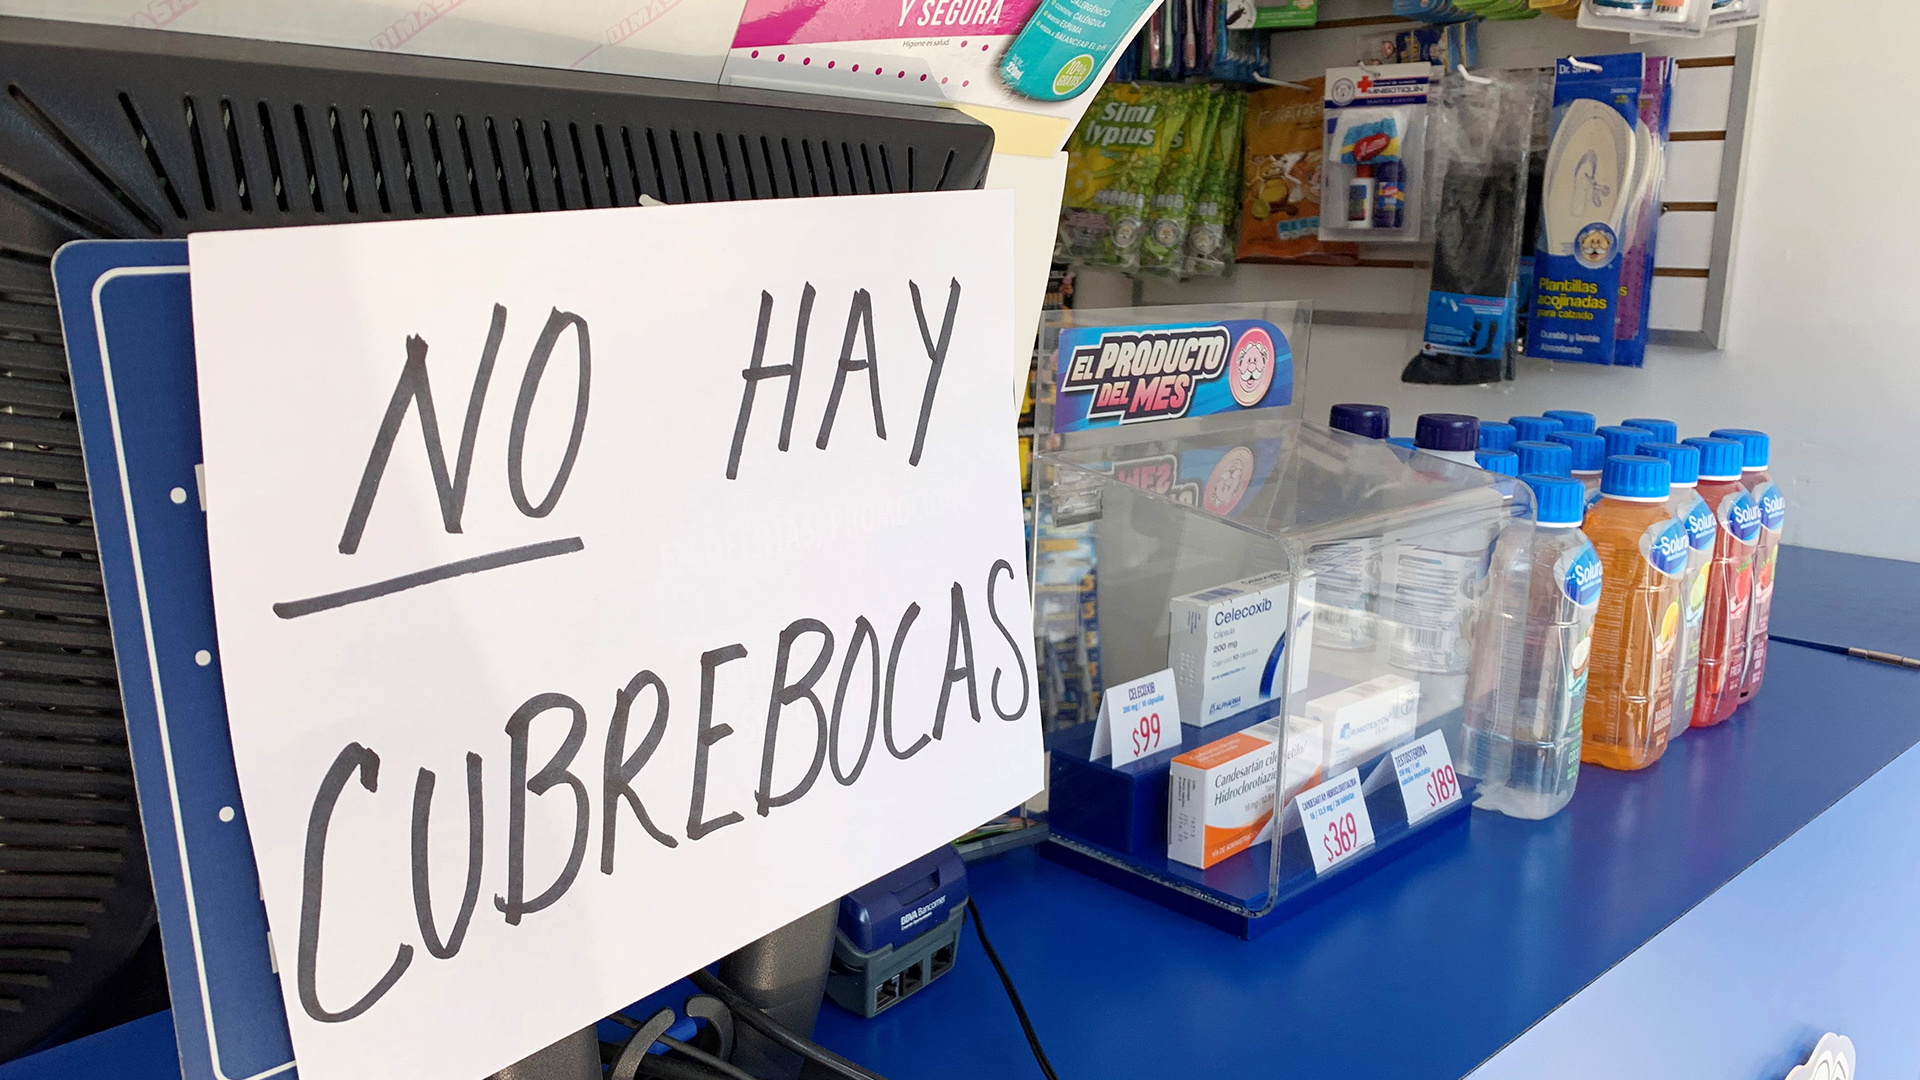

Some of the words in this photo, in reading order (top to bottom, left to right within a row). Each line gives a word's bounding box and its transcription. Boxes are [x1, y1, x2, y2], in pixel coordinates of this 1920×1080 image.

[898, 0, 916, 27] Y
[917, 0, 1004, 26] SEGURA
[1059, 20, 1083, 34] ESPUMA
[902, 39, 926, 49] Higiene
[925, 39, 933, 47] es
[1054, 32, 1089, 49] BALANCEAR
[1101, 101, 1157, 124] Simi
[1085, 120, 1156, 147] lyptus
[1539, 277, 1598, 294] Plantillas
[1537, 293, 1607, 310] acojinadas
[1558, 309, 1594, 321] calzado
[1071, 354, 1096, 381] EL
[1094, 335, 1226, 379] PRODUCTO
[1096, 381, 1131, 408] DEL
[1129, 373, 1190, 414] MES
[337, 303, 591, 555] NO
[726, 277, 962, 481] HAY
[1214, 598, 1272, 626] Celecoxib
[1213, 643, 1226, 654] 200
[1227, 640, 1238, 650] mg
[1232, 653, 1240, 662] 10
[1128, 681, 1156, 701] CELECOXIB
[1132, 712, 1161, 757] $99
[1394, 744, 1428, 768] TESTOSTERONA
[1215, 755, 1264, 789] Candesartán
[298, 558, 1029, 1023] CUBREBOCAS
[1426, 764, 1457, 807] $189
[1302, 793, 1327, 811] CANDESARTÁN
[1323, 812, 1358, 863] $369
[900, 910, 918, 926] BBVA
[917, 894, 946, 917] Bancomer
